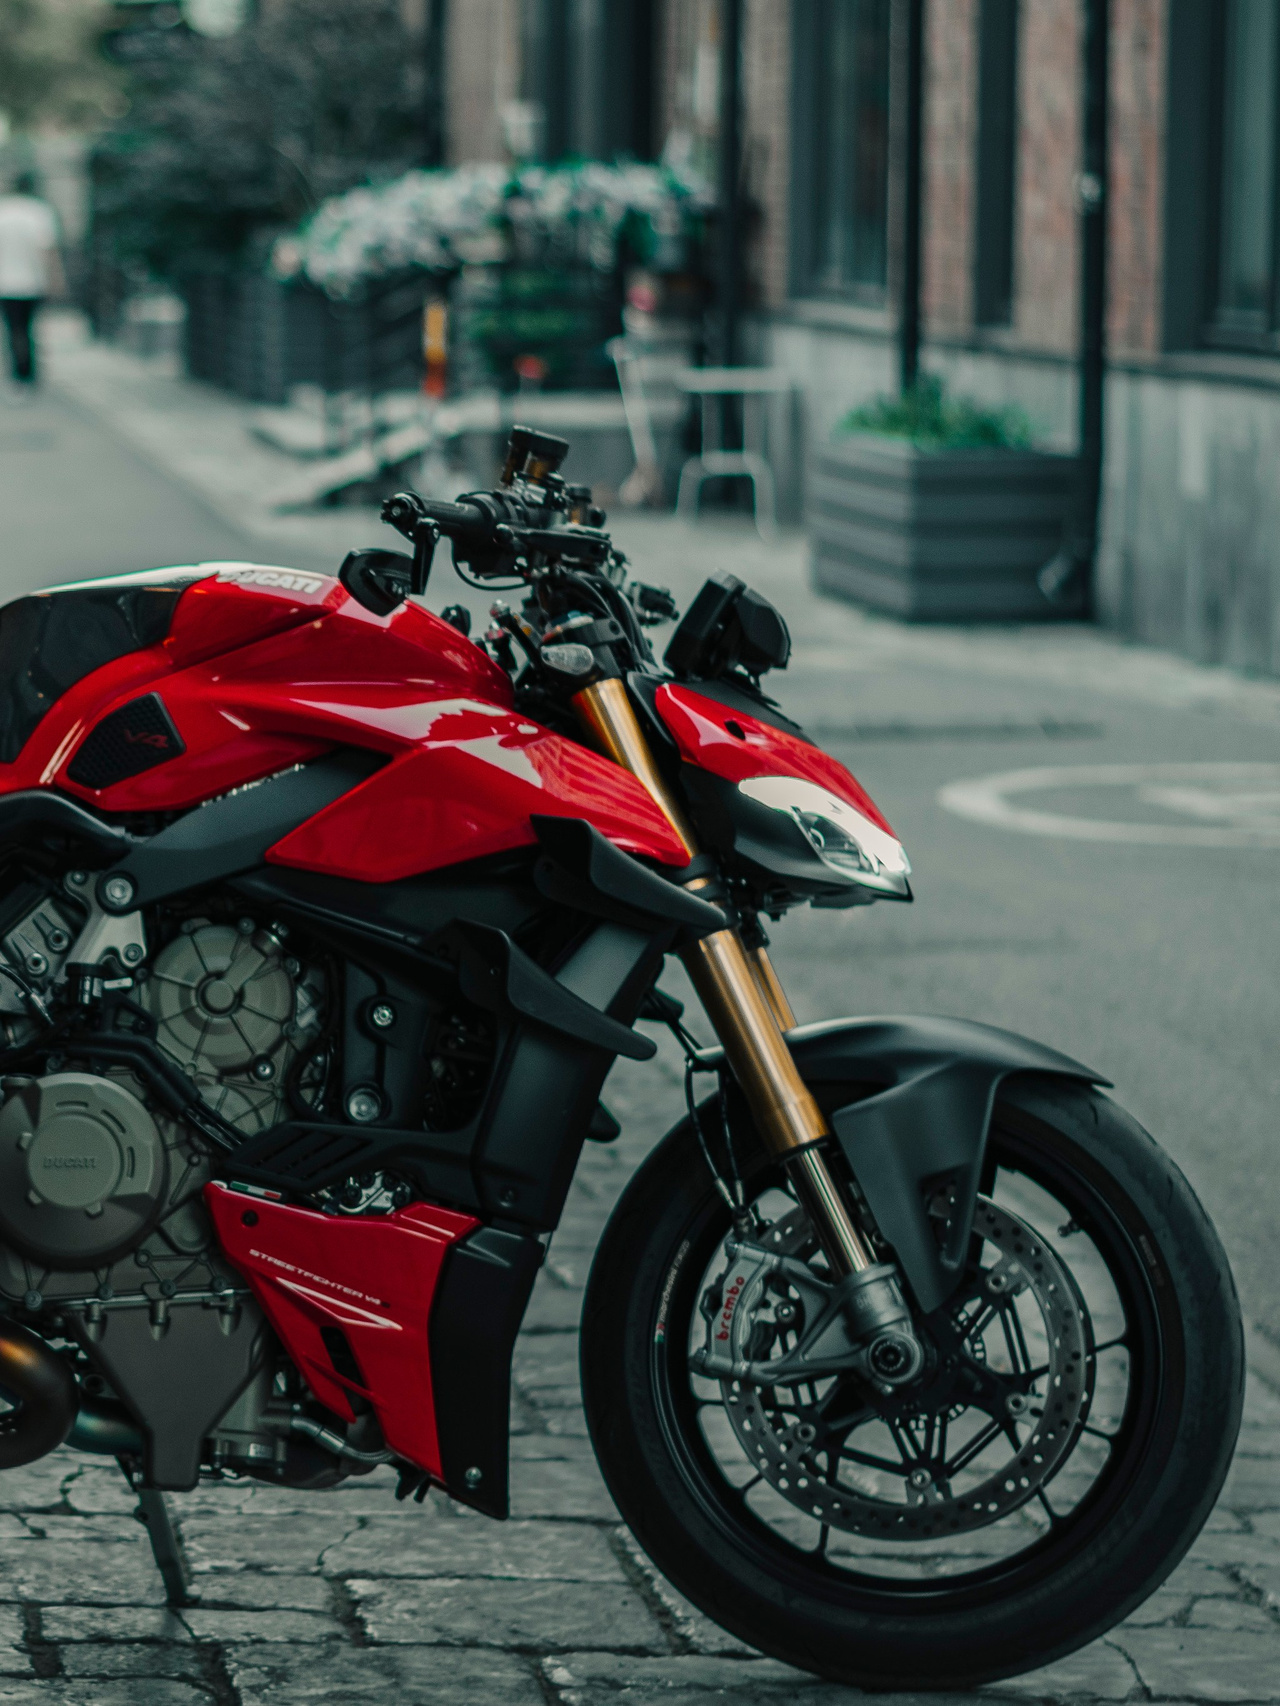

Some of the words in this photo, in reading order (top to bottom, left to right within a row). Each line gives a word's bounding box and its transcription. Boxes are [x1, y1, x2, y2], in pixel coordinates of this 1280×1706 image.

[216, 568, 322, 594] DUCATI
[42, 1157, 97, 1169] DUCATI
[249, 1248, 363, 1298] STREETFIGHTER
[716, 1276, 745, 1341] brembo
